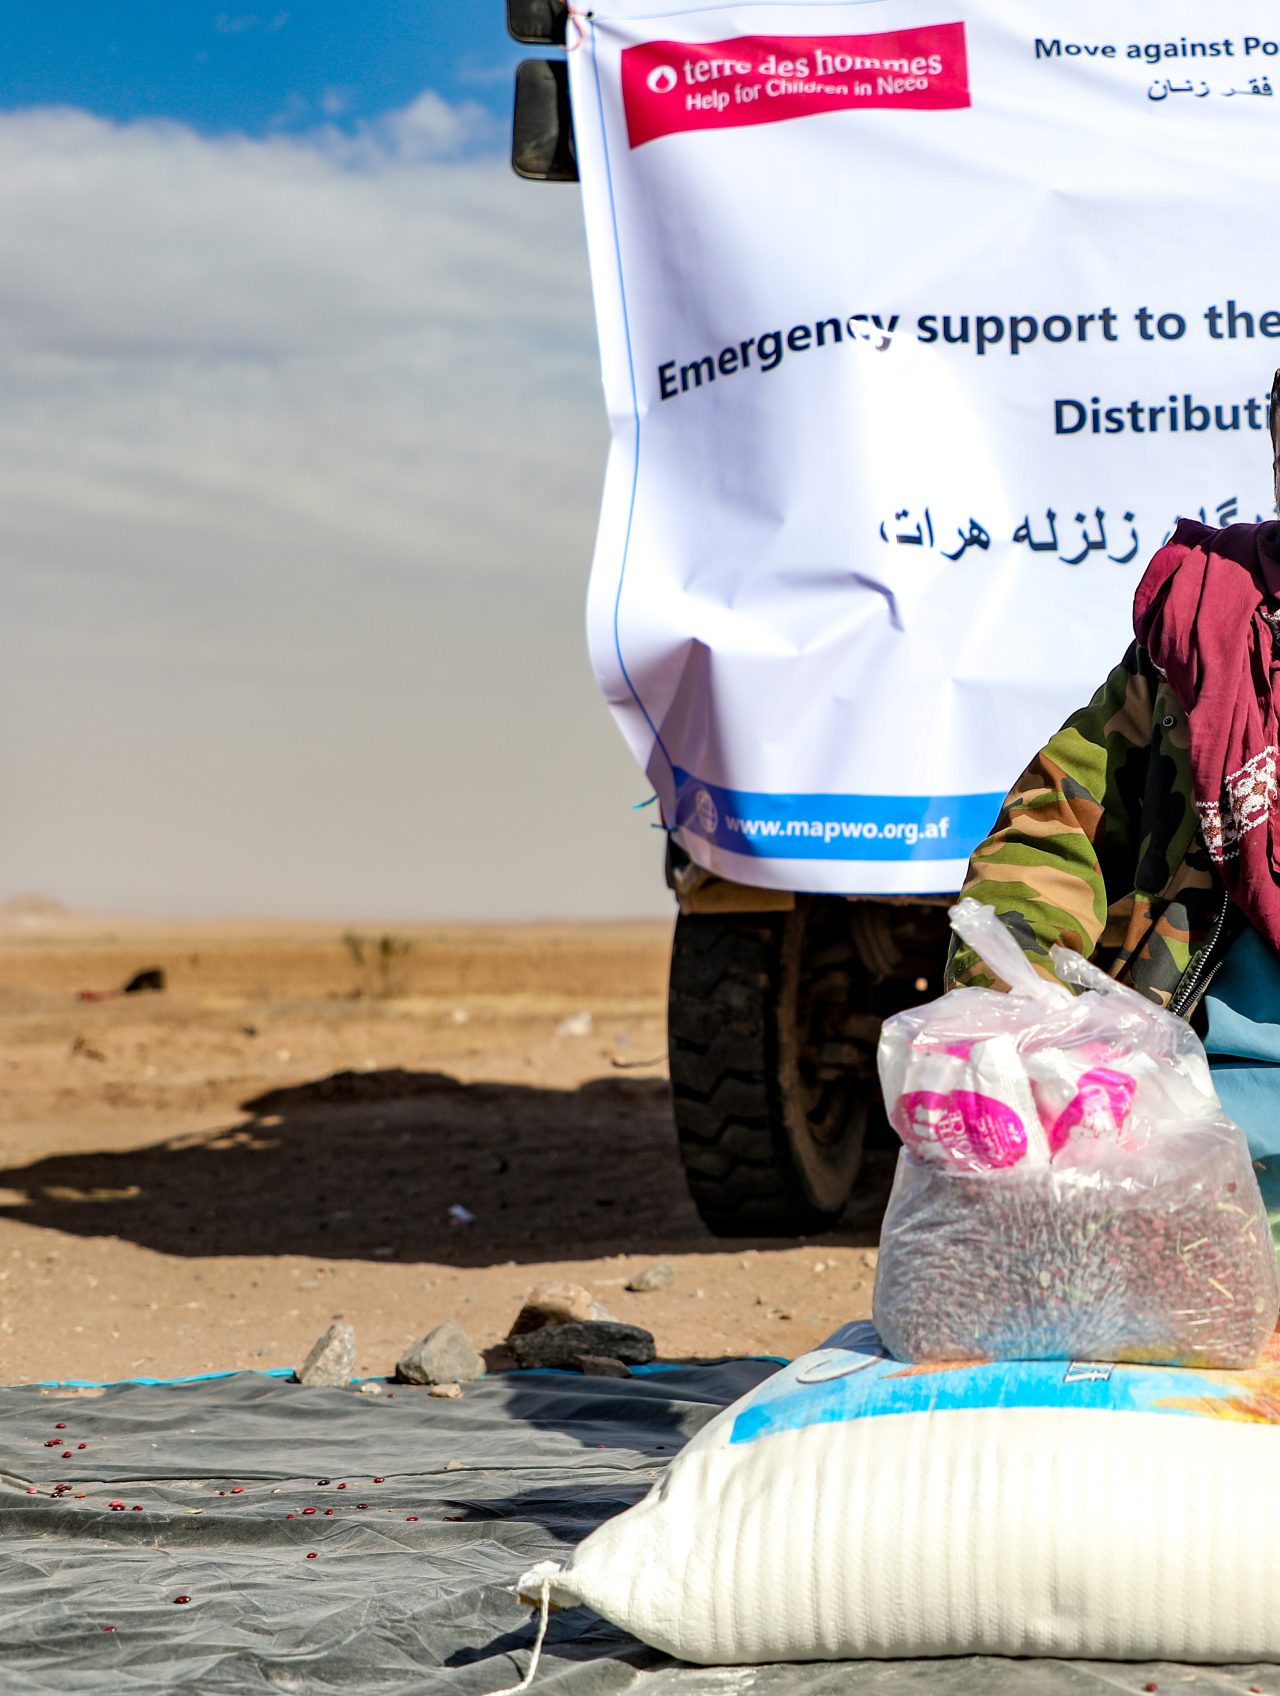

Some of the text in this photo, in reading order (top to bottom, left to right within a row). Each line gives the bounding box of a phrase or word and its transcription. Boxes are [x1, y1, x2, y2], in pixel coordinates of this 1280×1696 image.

[683, 48, 943, 85] terre des hommes
[1034, 38, 1117, 60] Move
[1126, 37, 1235, 64] against
[685, 87, 730, 113] Help
[734, 81, 761, 104] for
[765, 78, 849, 98] Children
[853, 80, 872, 96] in
[1147, 78, 1210, 101] زنان
[1220, 76, 1273, 97] فقر
[917, 306, 1118, 356] support
[1134, 306, 1187, 341] to
[1054, 393, 1273, 435] Distributi
[1012, 506, 1139, 565] زلزله
[724, 815, 950, 845] www.mapwo.org.af
